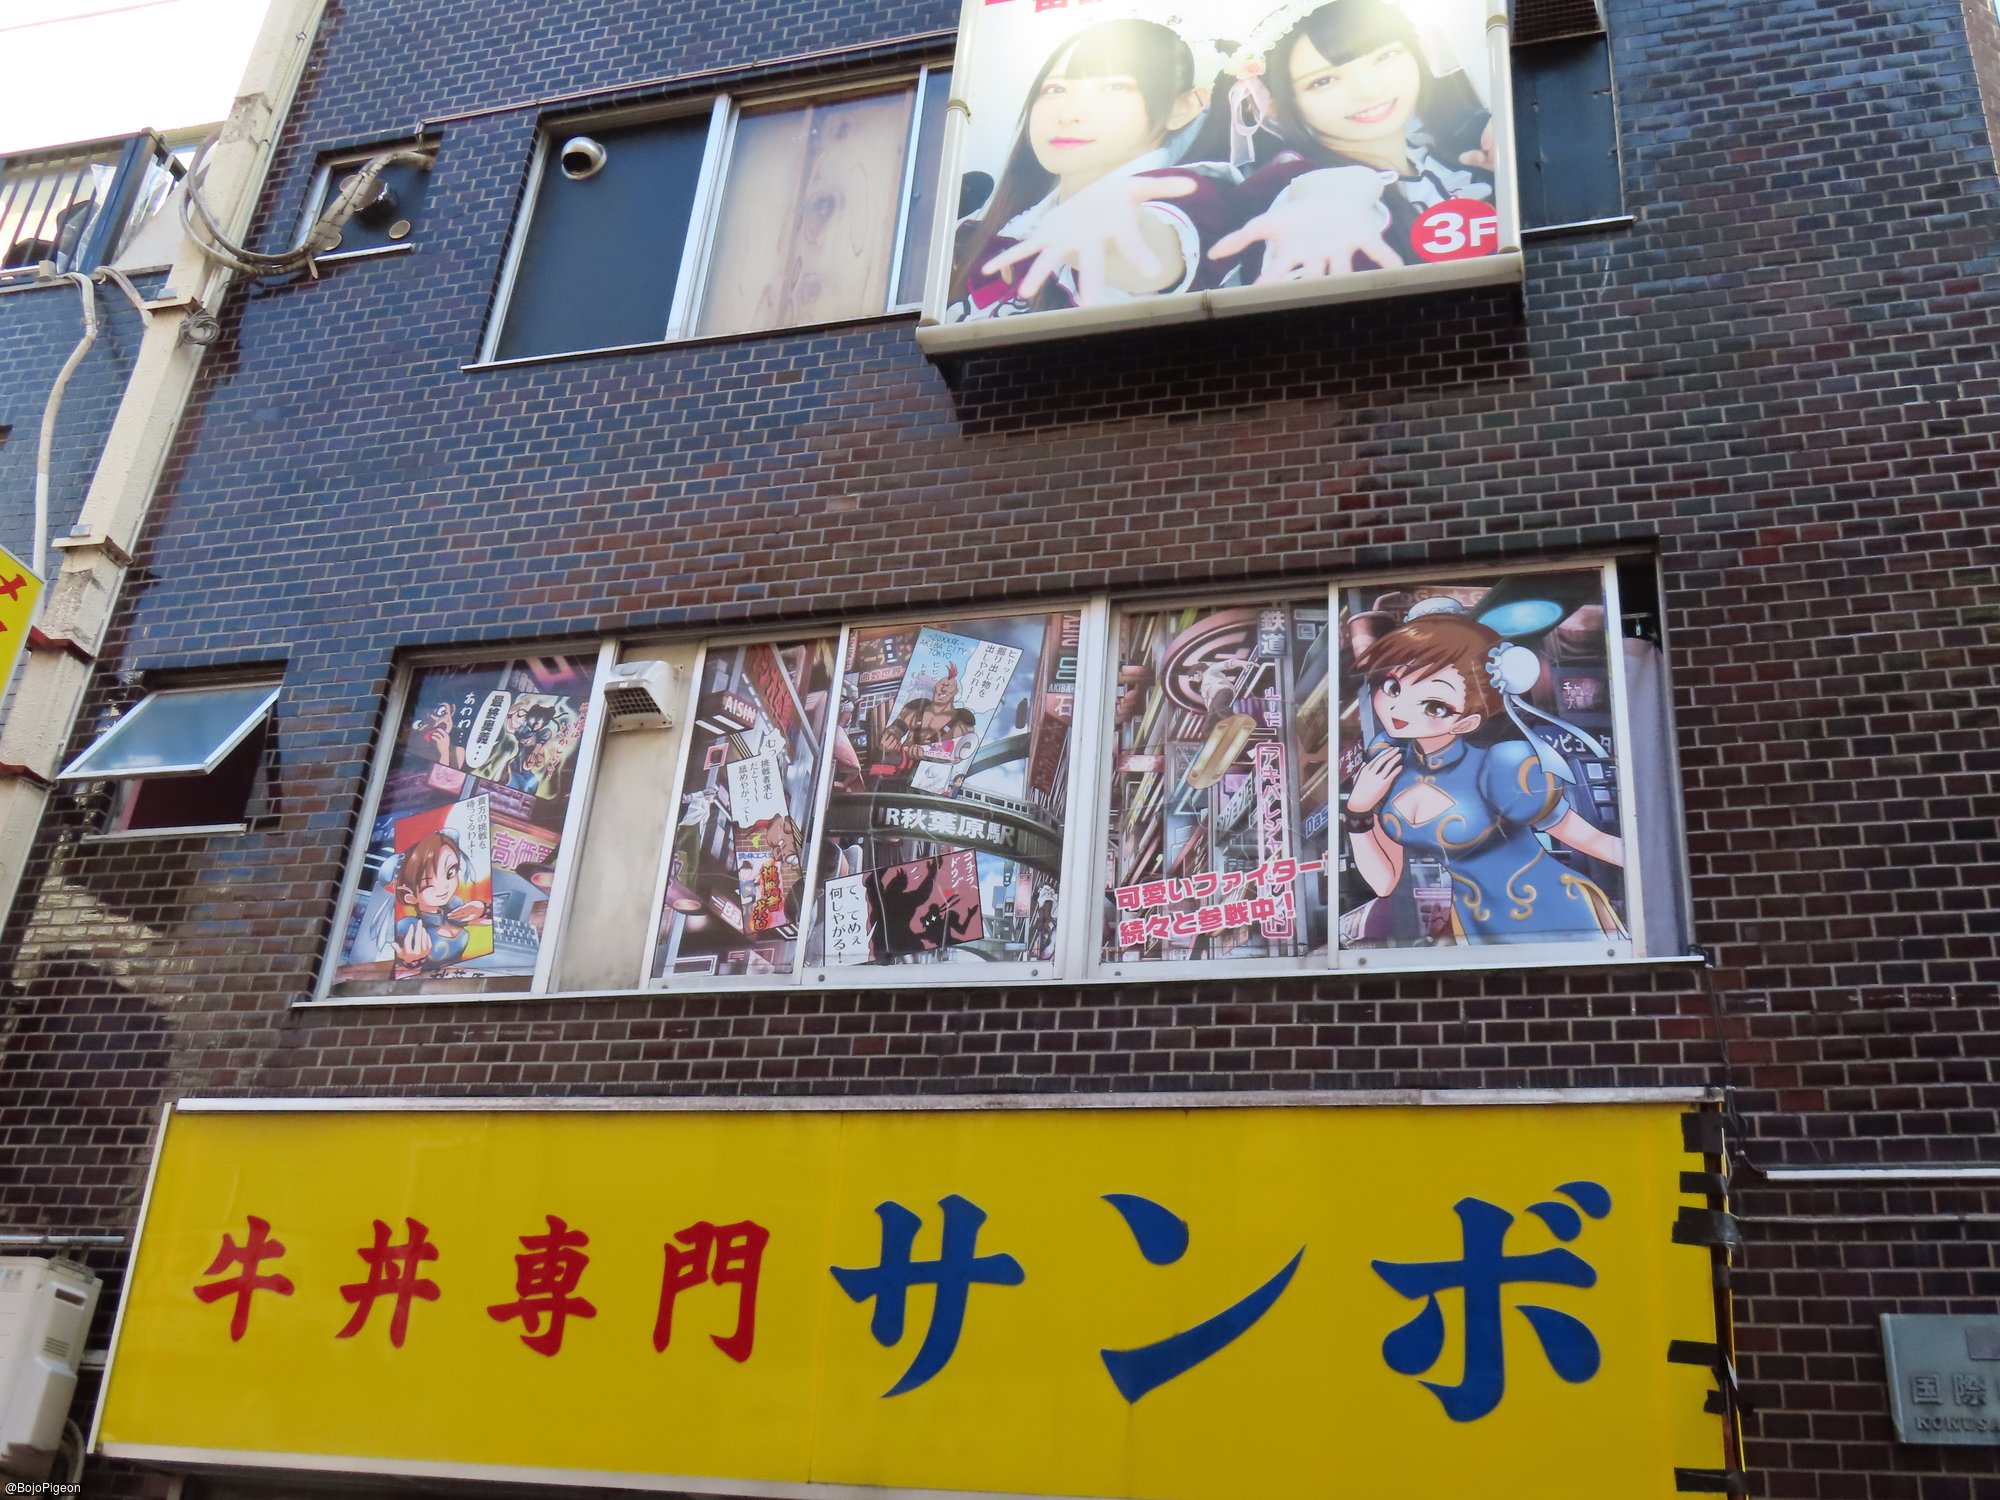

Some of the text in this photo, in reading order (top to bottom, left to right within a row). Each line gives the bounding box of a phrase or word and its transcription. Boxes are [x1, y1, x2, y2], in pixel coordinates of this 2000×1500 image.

[1422, 212, 1497, 254] 3F
[928, 647, 952, 659] TOKYO
[1260, 610, 1286, 655] 鉄道
[724, 696, 757, 724] AISIN
[1054, 695, 1073, 716] 石
[760, 759, 773, 801] 挑戦者求む
[477, 797, 488, 850] 貴方の挑戦を
[950, 857, 964, 888] ドウゾ
[1115, 857, 1328, 910] 可愛いファイター
[1119, 893, 1297, 946] 続々と参戦中！
[192, 1180, 1612, 1422] 牛丼専門 サンボ
[1911, 1373, 2000, 1406] 国際
